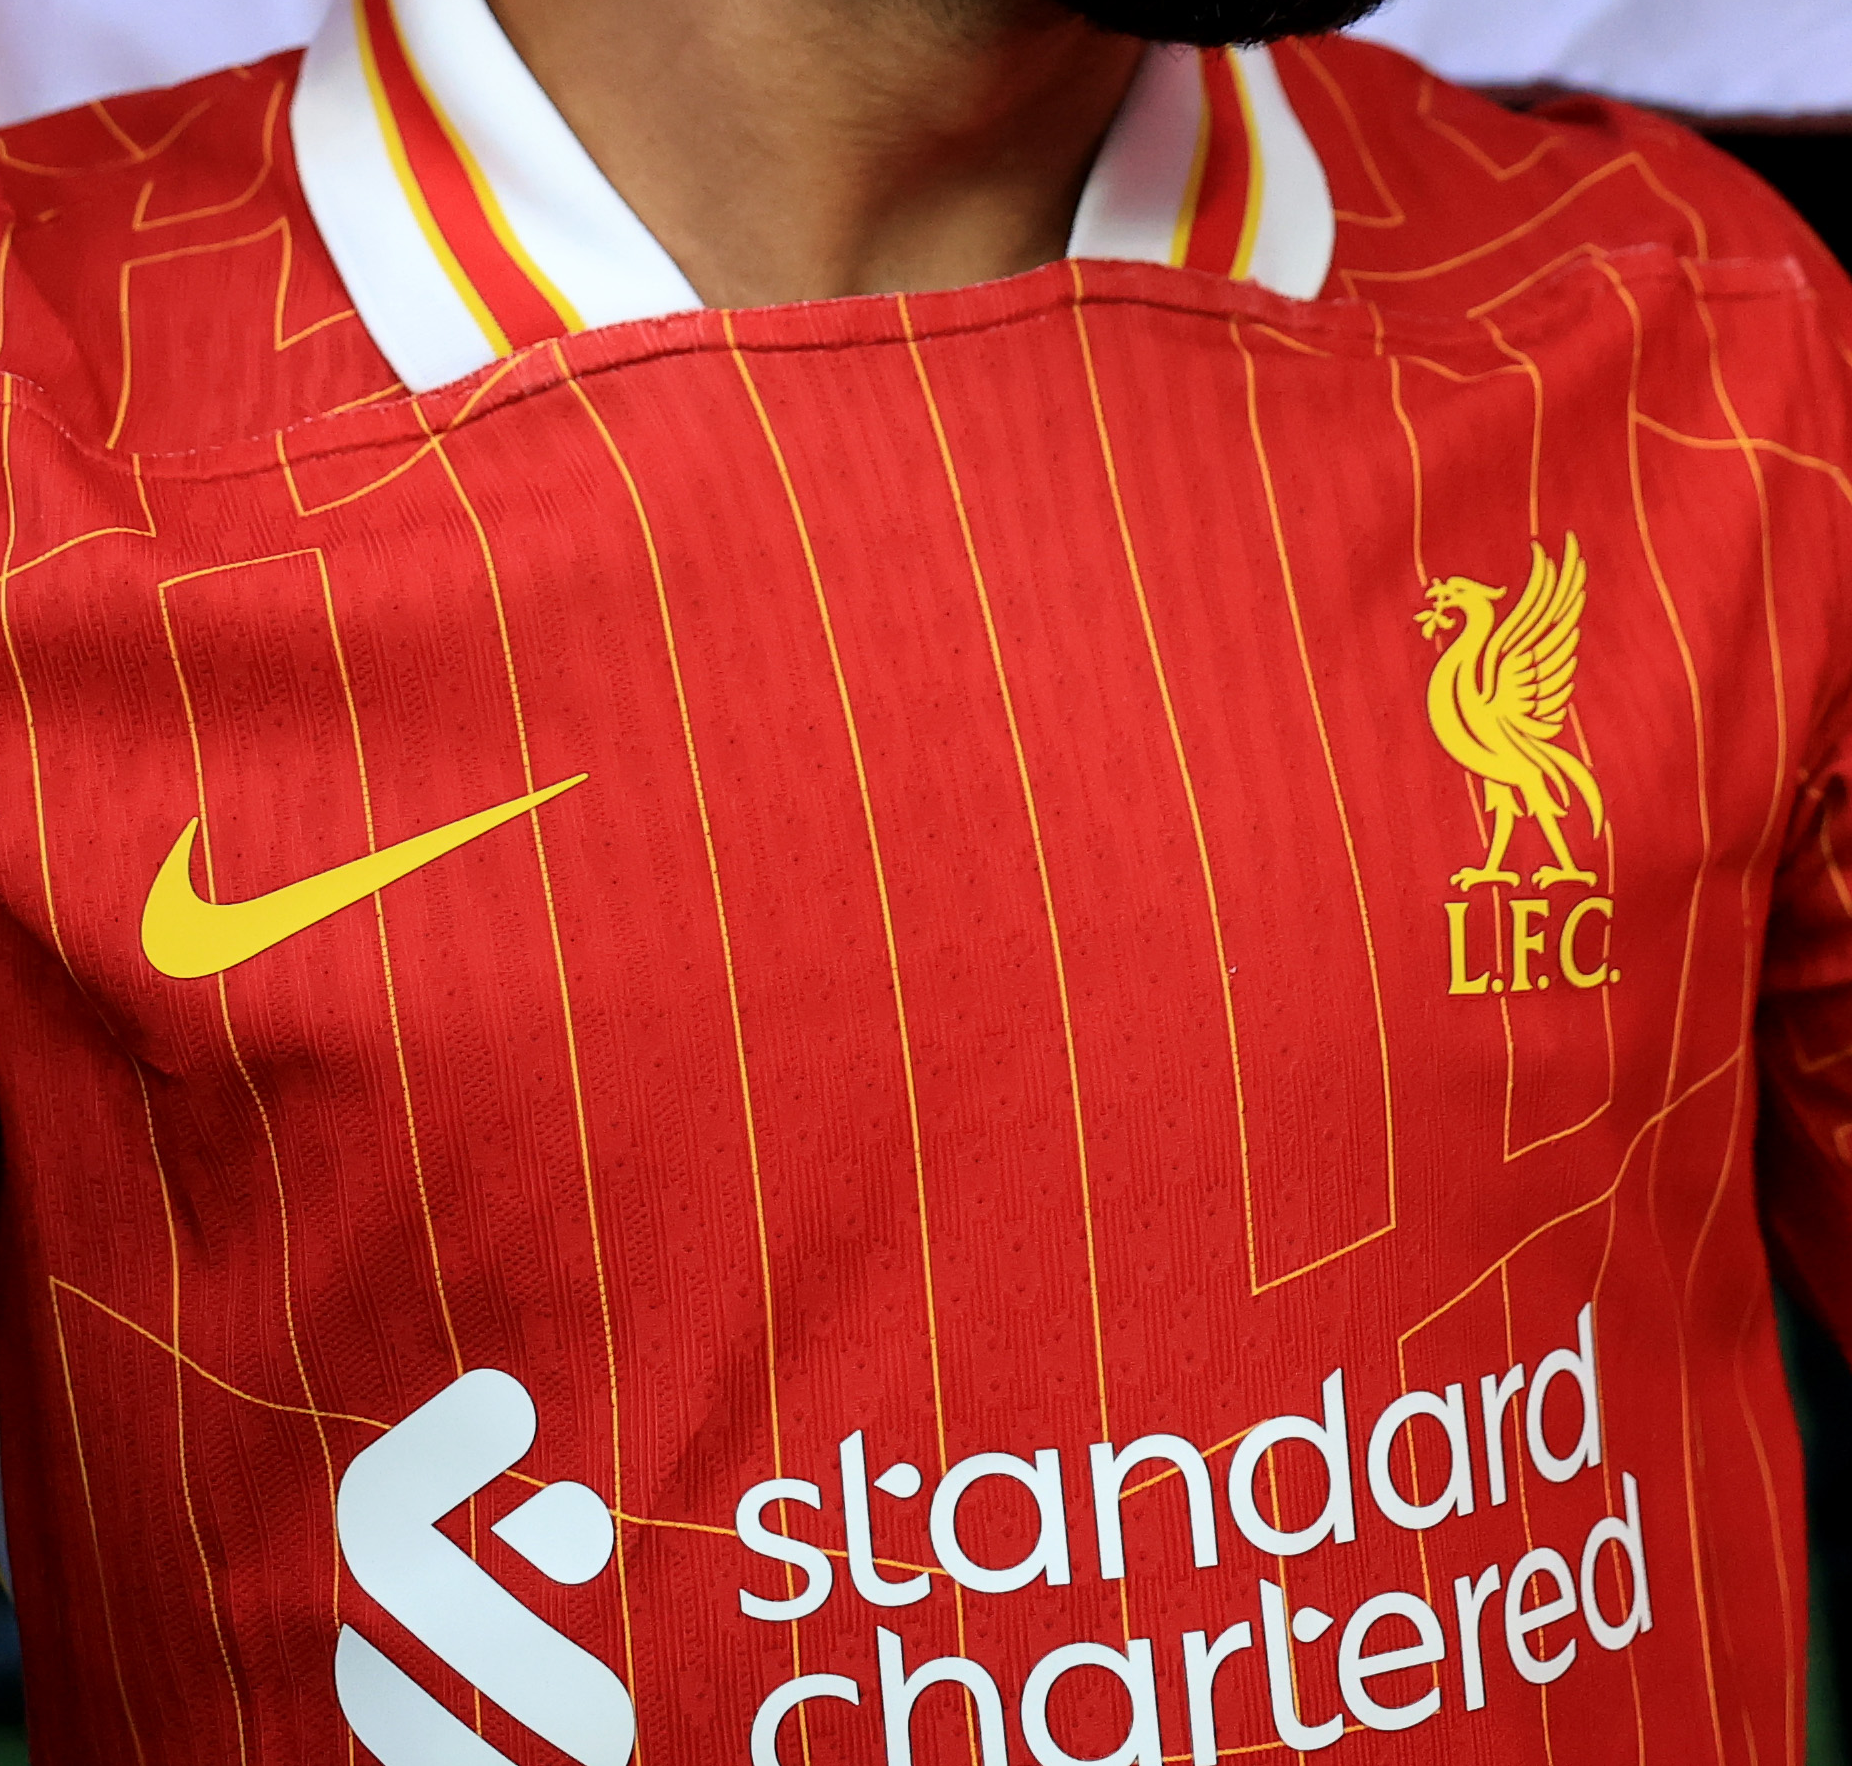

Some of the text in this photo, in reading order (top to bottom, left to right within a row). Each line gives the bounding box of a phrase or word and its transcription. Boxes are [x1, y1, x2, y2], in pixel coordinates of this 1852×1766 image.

[1444, 897, 1621, 995] L.F.C.
[735, 1302, 1605, 1622] standard
[750, 1471, 1654, 1766] chartered
